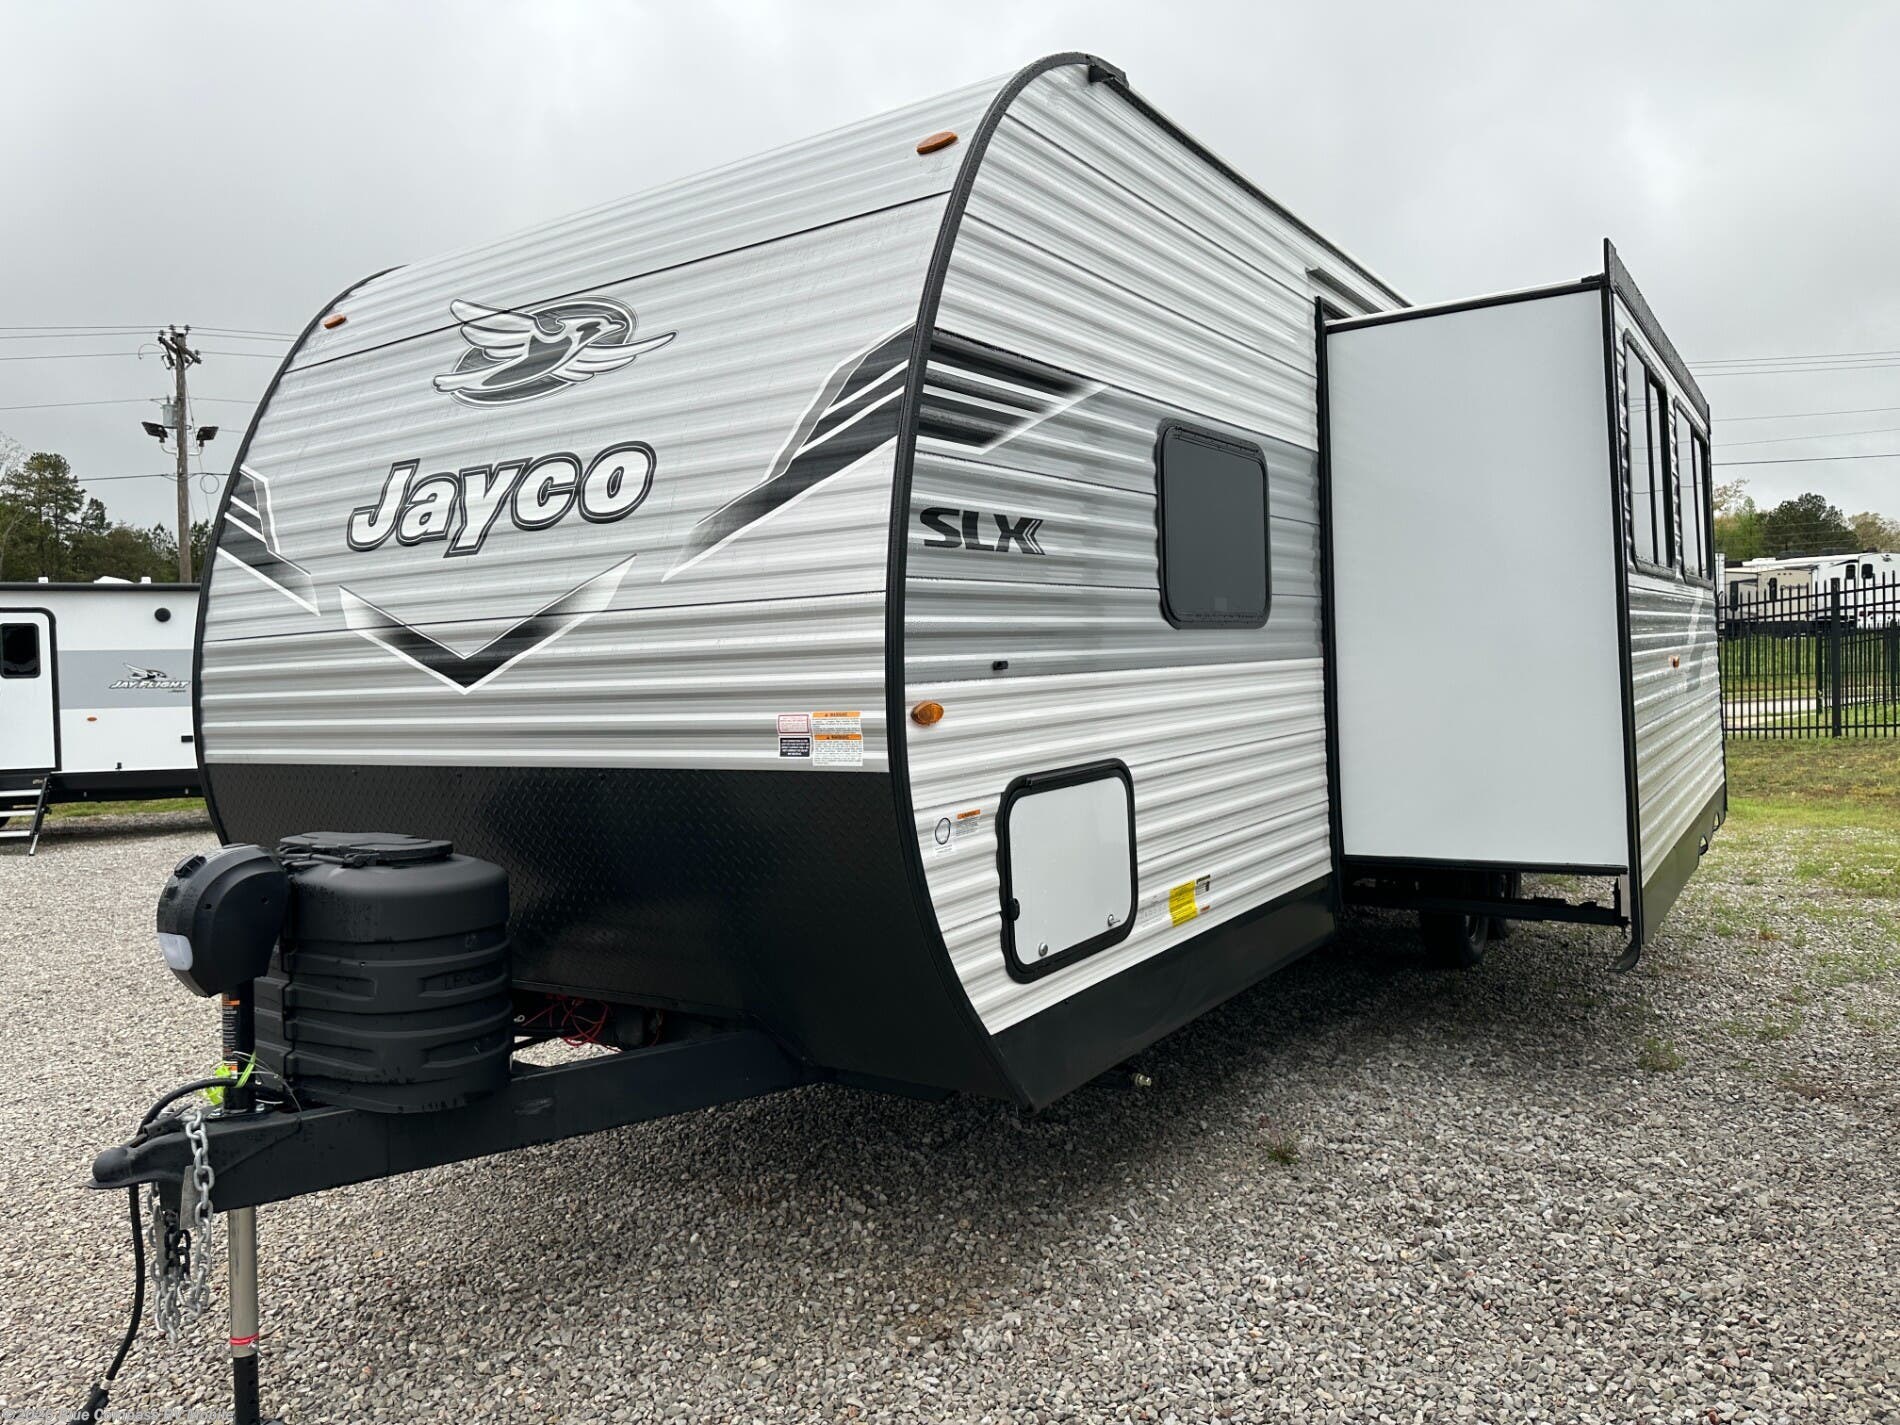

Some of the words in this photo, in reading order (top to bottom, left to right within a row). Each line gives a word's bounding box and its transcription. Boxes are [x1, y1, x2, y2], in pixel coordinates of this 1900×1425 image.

[346, 438, 657, 558] Jayco
[920, 506, 1045, 555] SLX
[109, 680, 137, 689] JAY
[138, 680, 190, 689] FLIGHT
